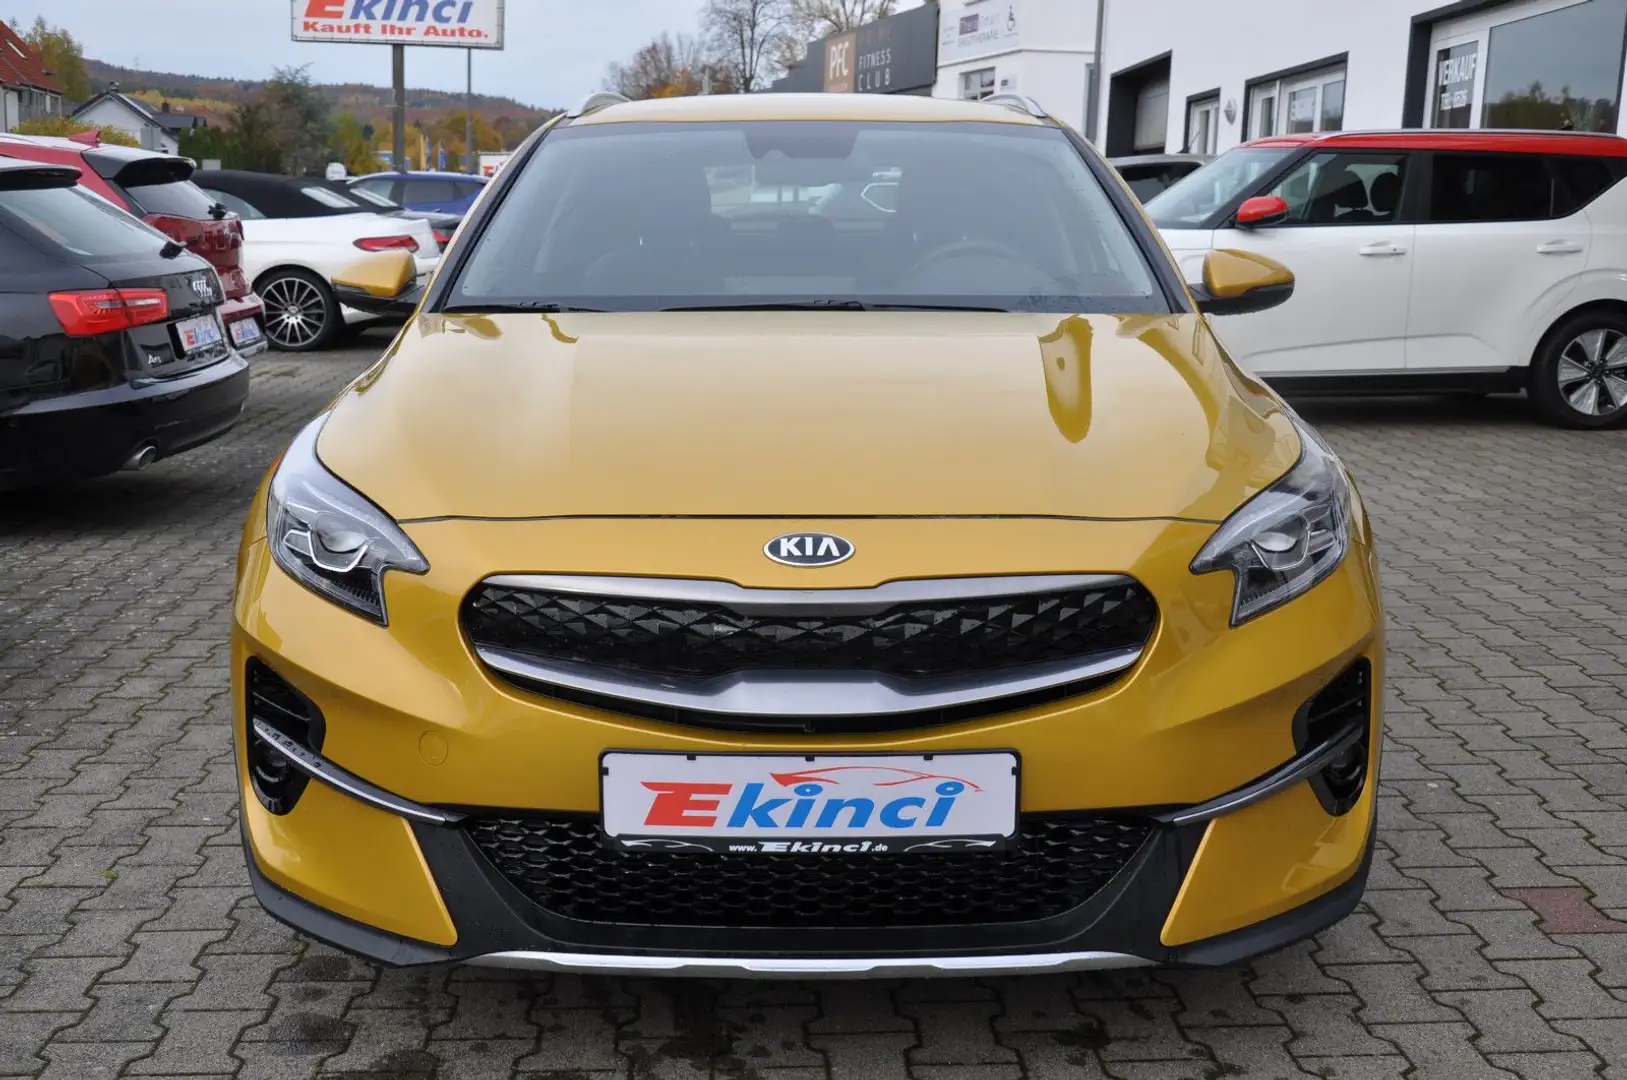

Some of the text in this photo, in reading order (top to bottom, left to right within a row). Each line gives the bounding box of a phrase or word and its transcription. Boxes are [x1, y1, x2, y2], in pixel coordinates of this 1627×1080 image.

[304, 0, 474, 23] Ekinci
[303, 20, 489, 39] Kauft Ihr Auto.
[829, 41, 849, 80] PFC
[859, 47, 891, 71] FITNESS
[1438, 53, 1477, 86] VERKAUF
[859, 67, 890, 92] CLUB
[779, 536, 841, 557] KIA
[641, 781, 965, 829] Ekinci
[728, 841, 889, 853] www.Ekinci.de
